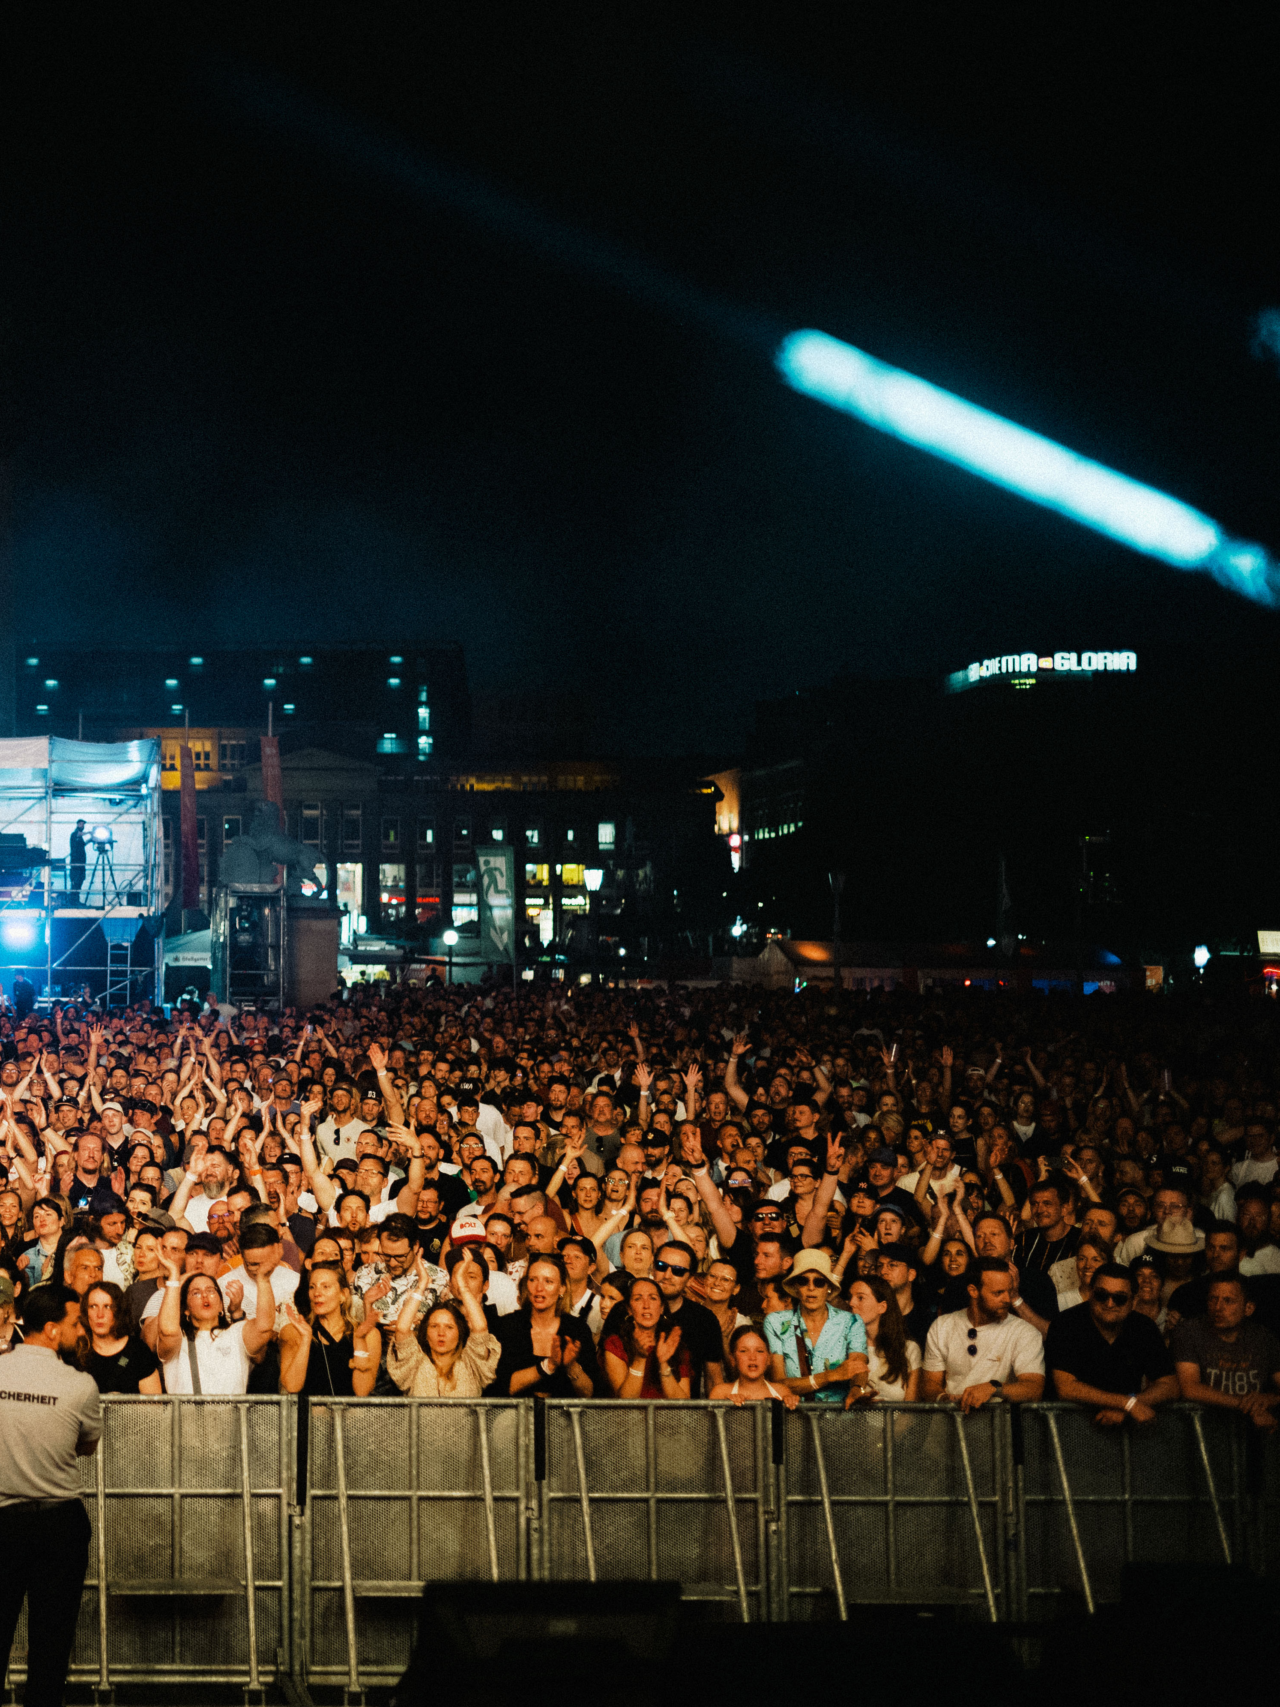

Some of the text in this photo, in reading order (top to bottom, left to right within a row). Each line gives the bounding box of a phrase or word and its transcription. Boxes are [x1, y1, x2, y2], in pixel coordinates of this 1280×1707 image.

[1054, 652, 1137, 672] GLORIA
[1171, 1165, 1188, 1174] VANS
[1206, 1367, 1260, 1395] TH85
